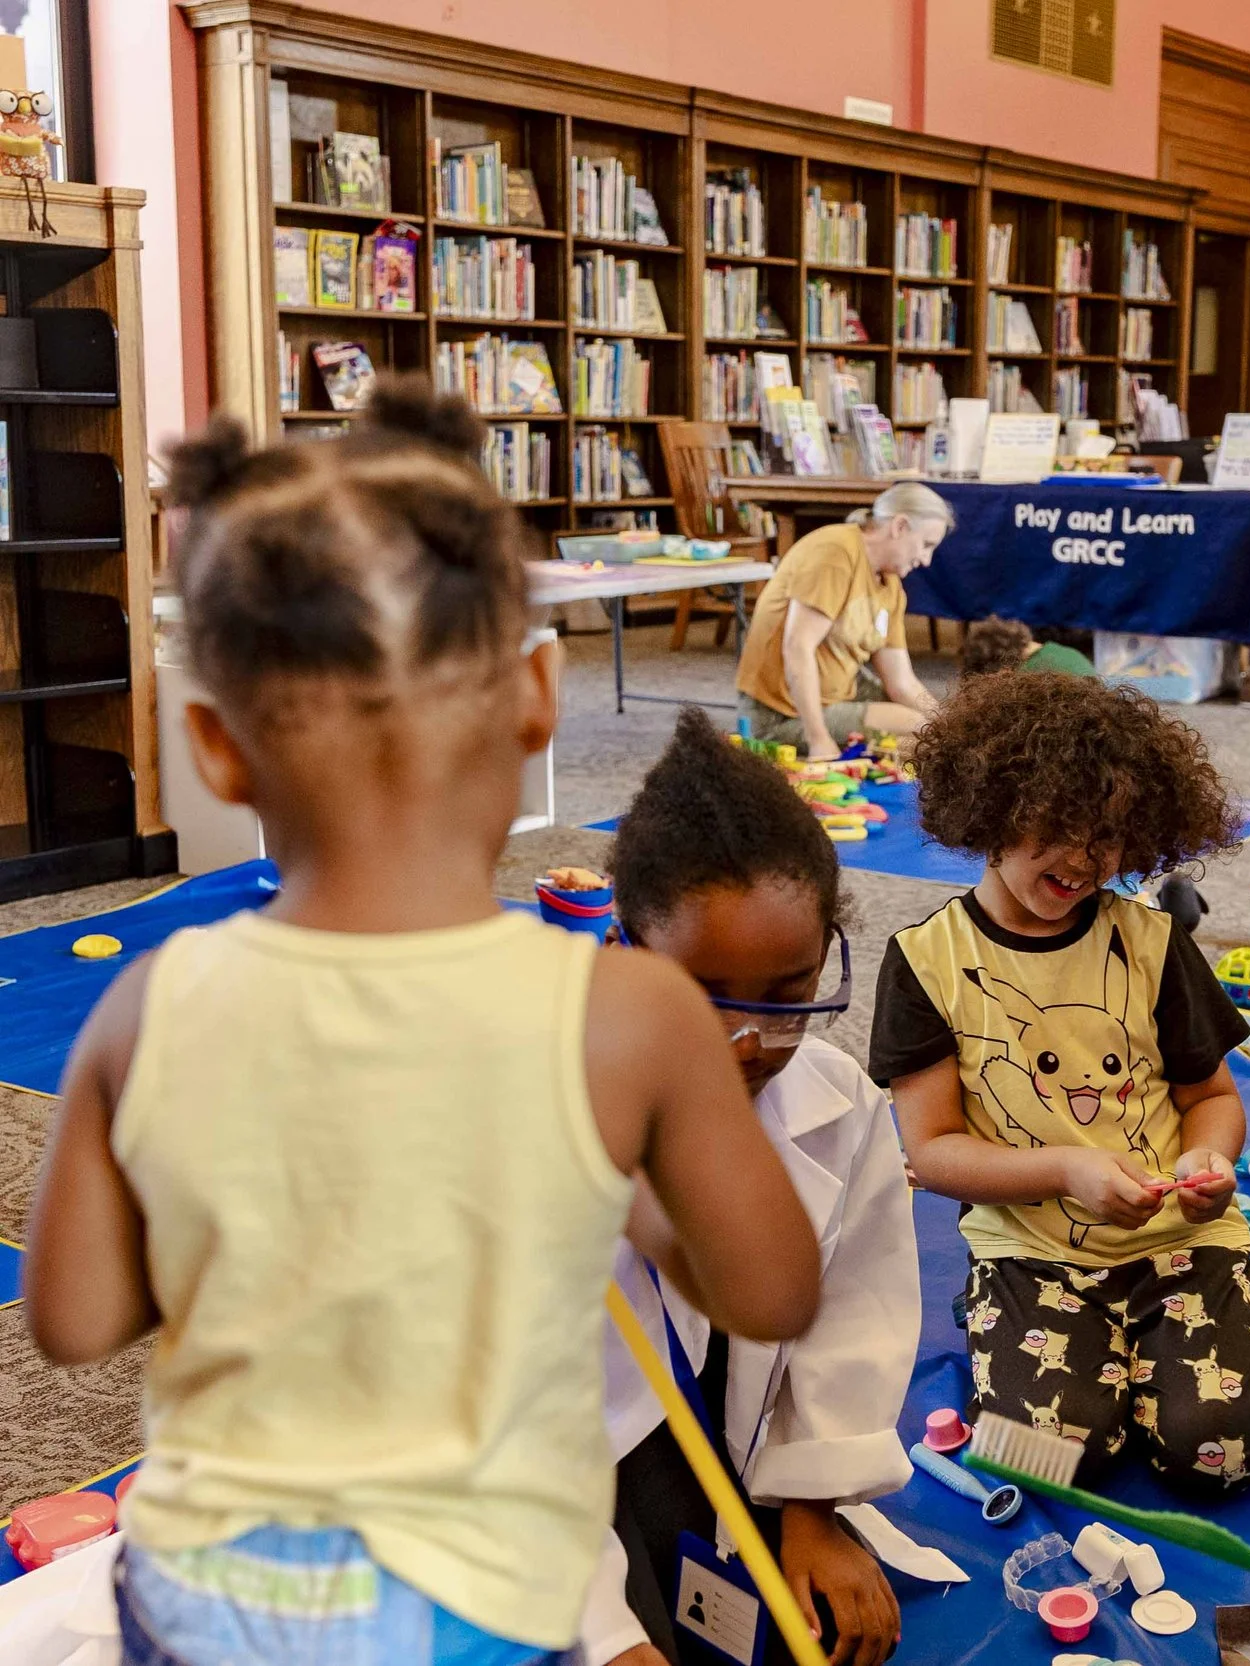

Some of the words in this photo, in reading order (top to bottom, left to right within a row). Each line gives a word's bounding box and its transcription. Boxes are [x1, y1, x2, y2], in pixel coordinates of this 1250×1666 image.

[1014, 502, 1061, 533] Play
[1067, 507, 1114, 533] and
[1121, 506, 1195, 535] Learn
[1051, 536, 1126, 567] GRCC
